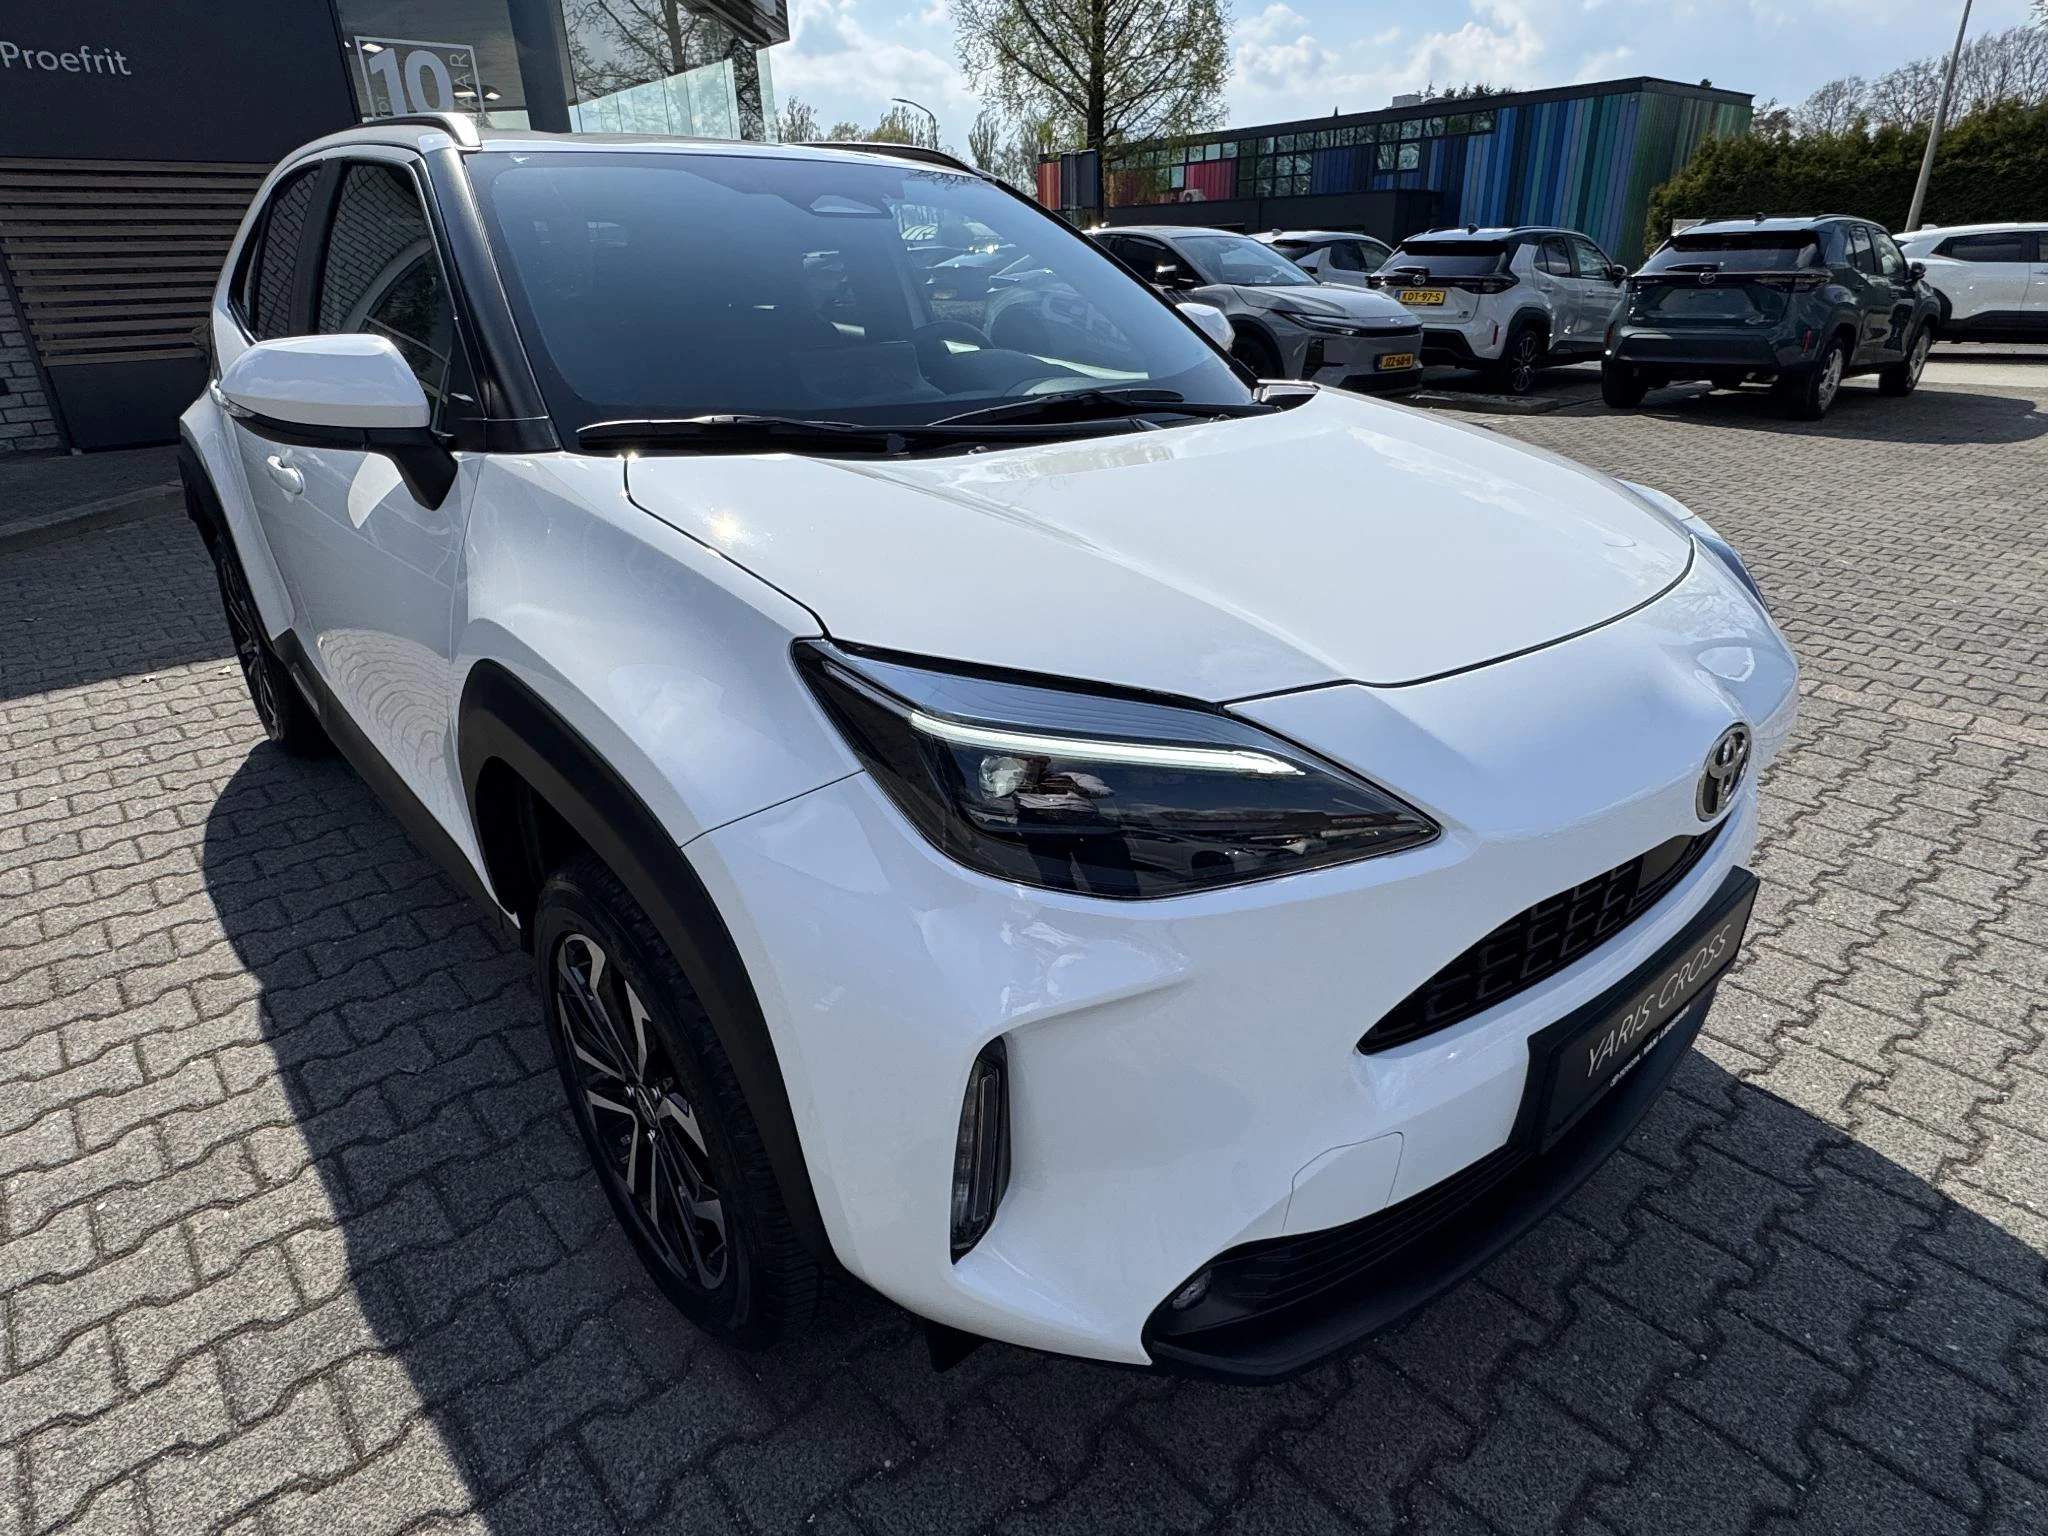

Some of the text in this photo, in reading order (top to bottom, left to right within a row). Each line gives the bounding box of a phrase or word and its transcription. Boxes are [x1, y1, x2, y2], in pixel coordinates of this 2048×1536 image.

[0, 41, 132, 76] Proefrit
[368, 47, 455, 115] 10
[449, 53, 478, 112] AAR
[1402, 292, 1441, 302] KDT-97-S
[1587, 993, 1656, 1078] YARIS
[1658, 923, 1731, 1009] CROSS
